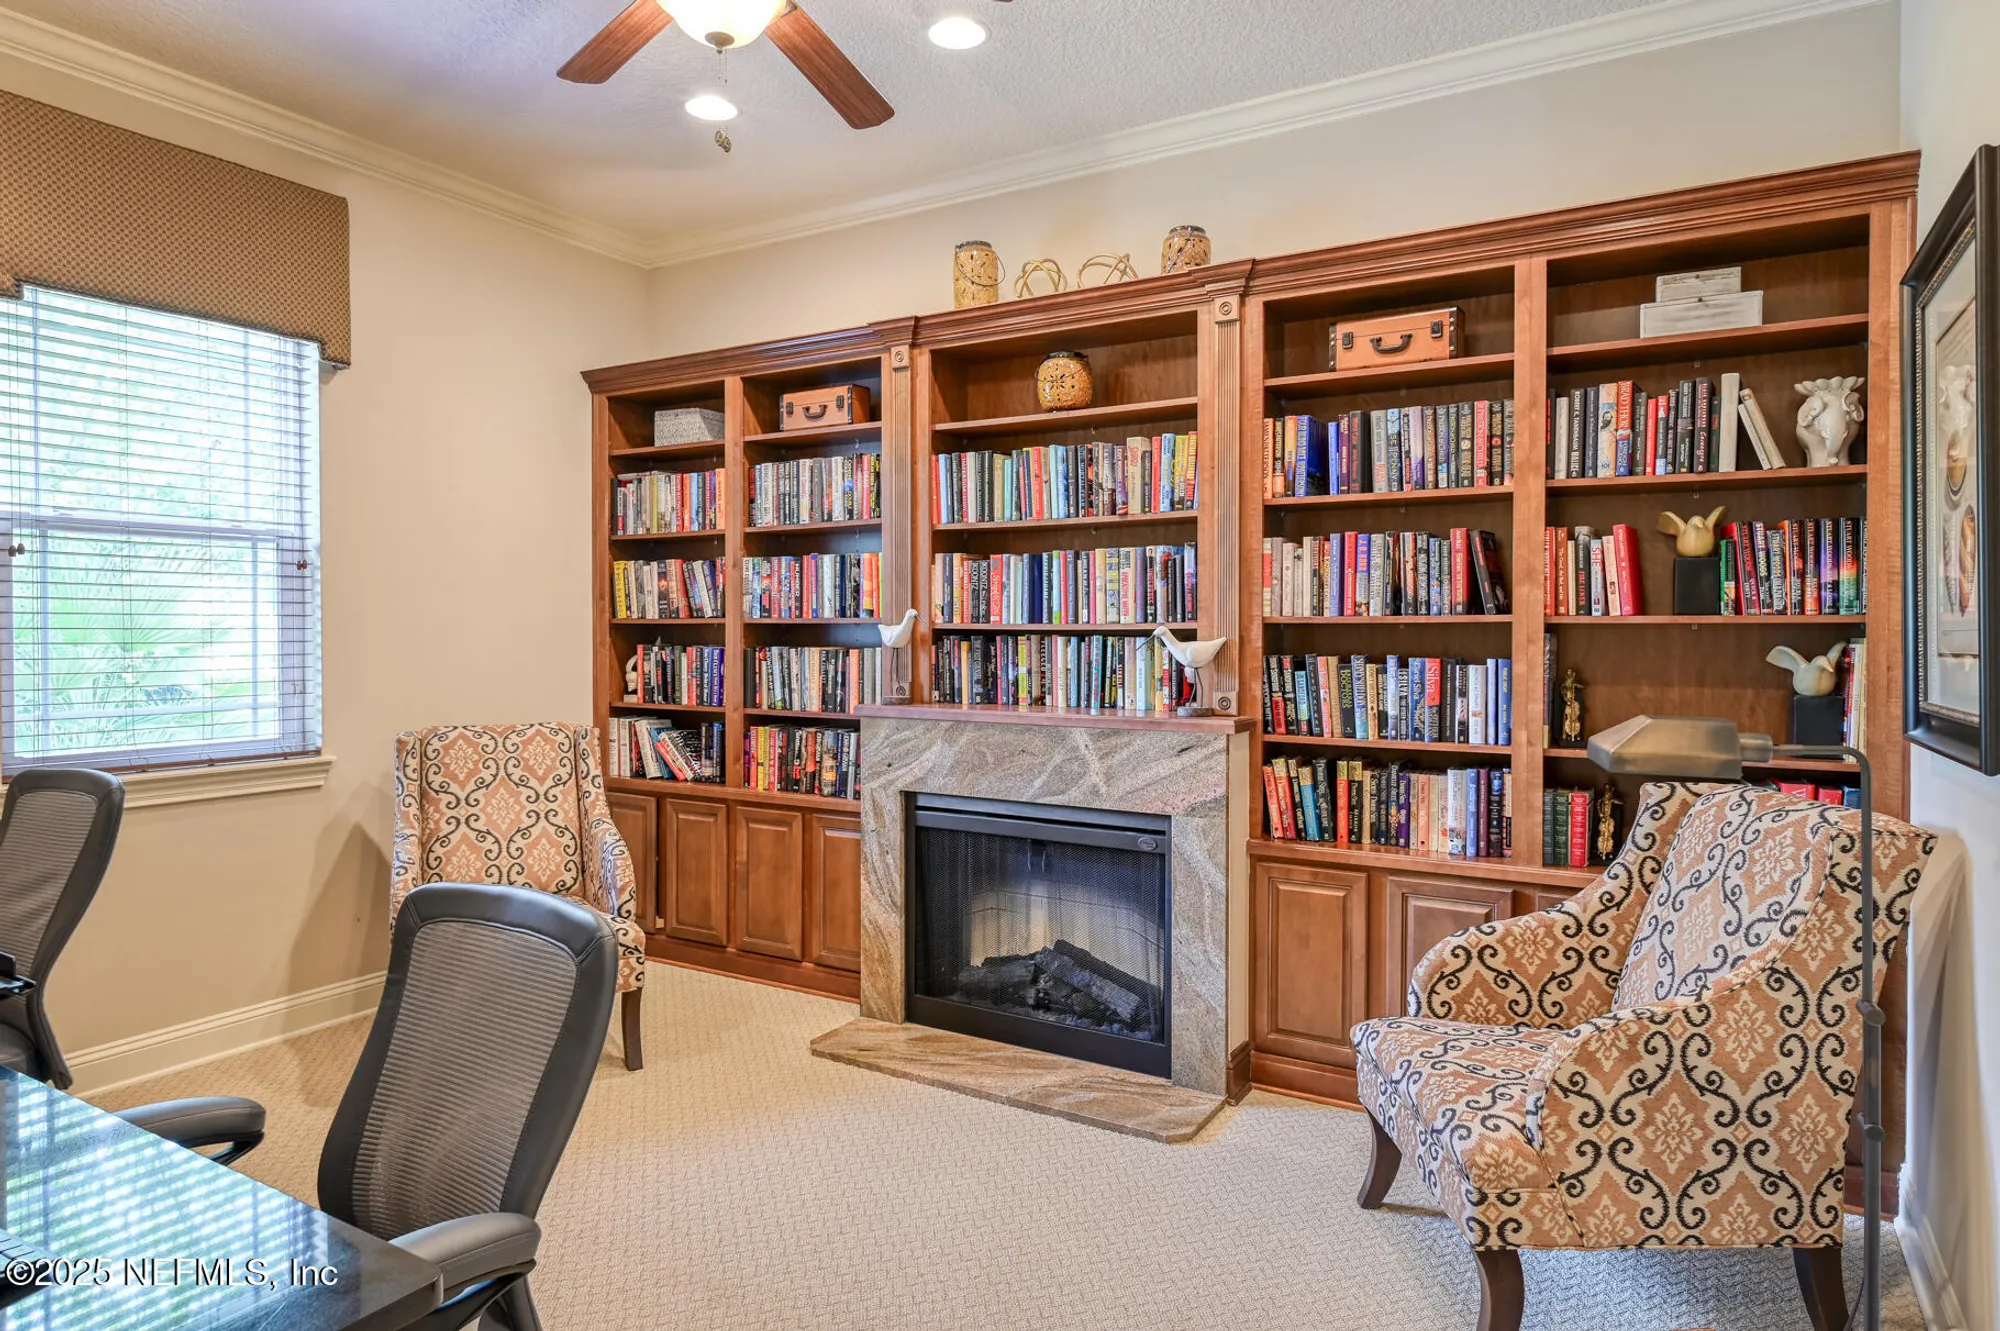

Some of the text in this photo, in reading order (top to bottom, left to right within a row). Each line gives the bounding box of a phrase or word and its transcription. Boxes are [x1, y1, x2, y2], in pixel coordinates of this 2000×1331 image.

[1618, 381, 1632, 430] BRAD THOR
[1572, 417, 1580, 451] TANENBAUM
[1592, 547, 1601, 567] SHE
[1755, 522, 1767, 577] STUART WOODS
[1772, 533, 1780, 555] STUART
[1340, 670, 1348, 708] DOCTORS
[1413, 683, 1422, 700] Silva
[1427, 665, 1439, 692] Silva
